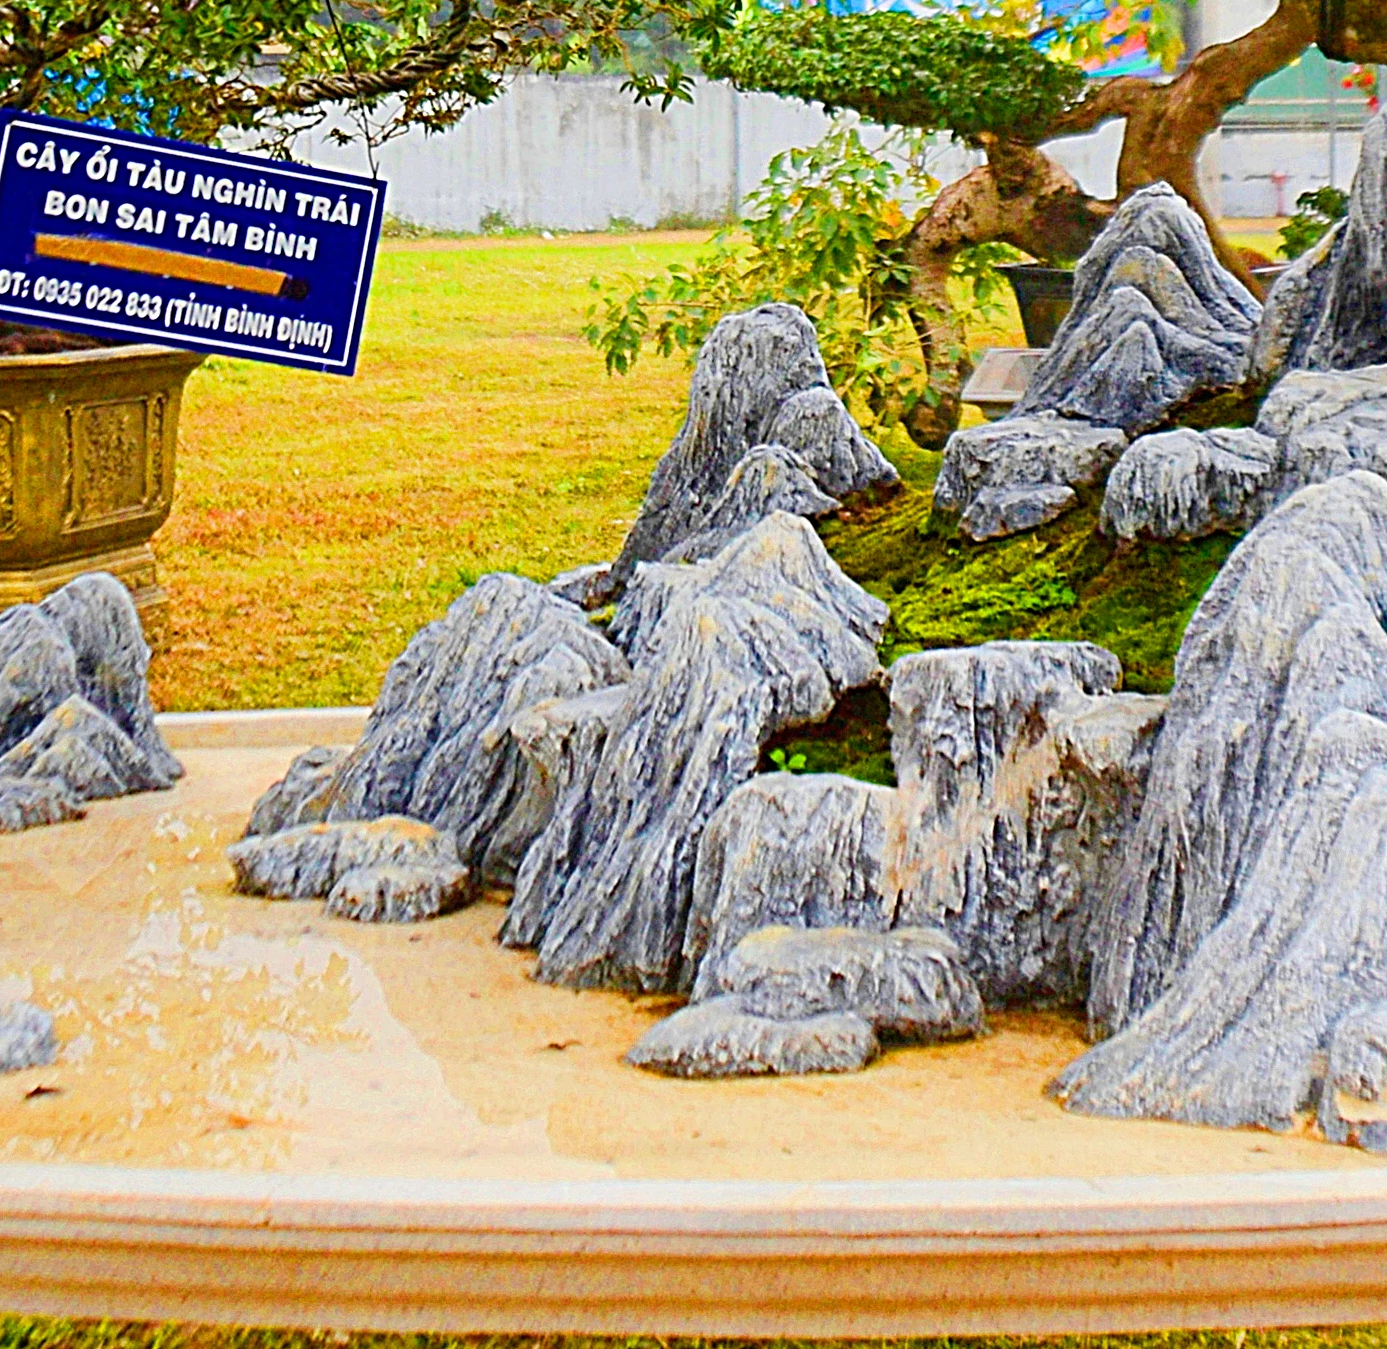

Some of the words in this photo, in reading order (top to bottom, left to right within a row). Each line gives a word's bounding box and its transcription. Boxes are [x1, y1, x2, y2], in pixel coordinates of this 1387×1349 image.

[16, 140, 81, 174] CÂY
[85, 144, 119, 183] ỔI
[126, 158, 186, 195] TÀU
[191, 174, 287, 213] NGHÌN
[295, 192, 361, 227] TRÁI
[43, 189, 110, 224] BON
[115, 202, 167, 235] SAI
[174, 211, 238, 248] TÂM
[244, 222, 318, 261] BÌNH
[33, 275, 83, 307] 0935
[85, 284, 124, 314] 022
[125, 291, 163, 321] 833
[164, 292, 222, 330] (TỈNH
[224, 303, 275, 339] BÌNH
